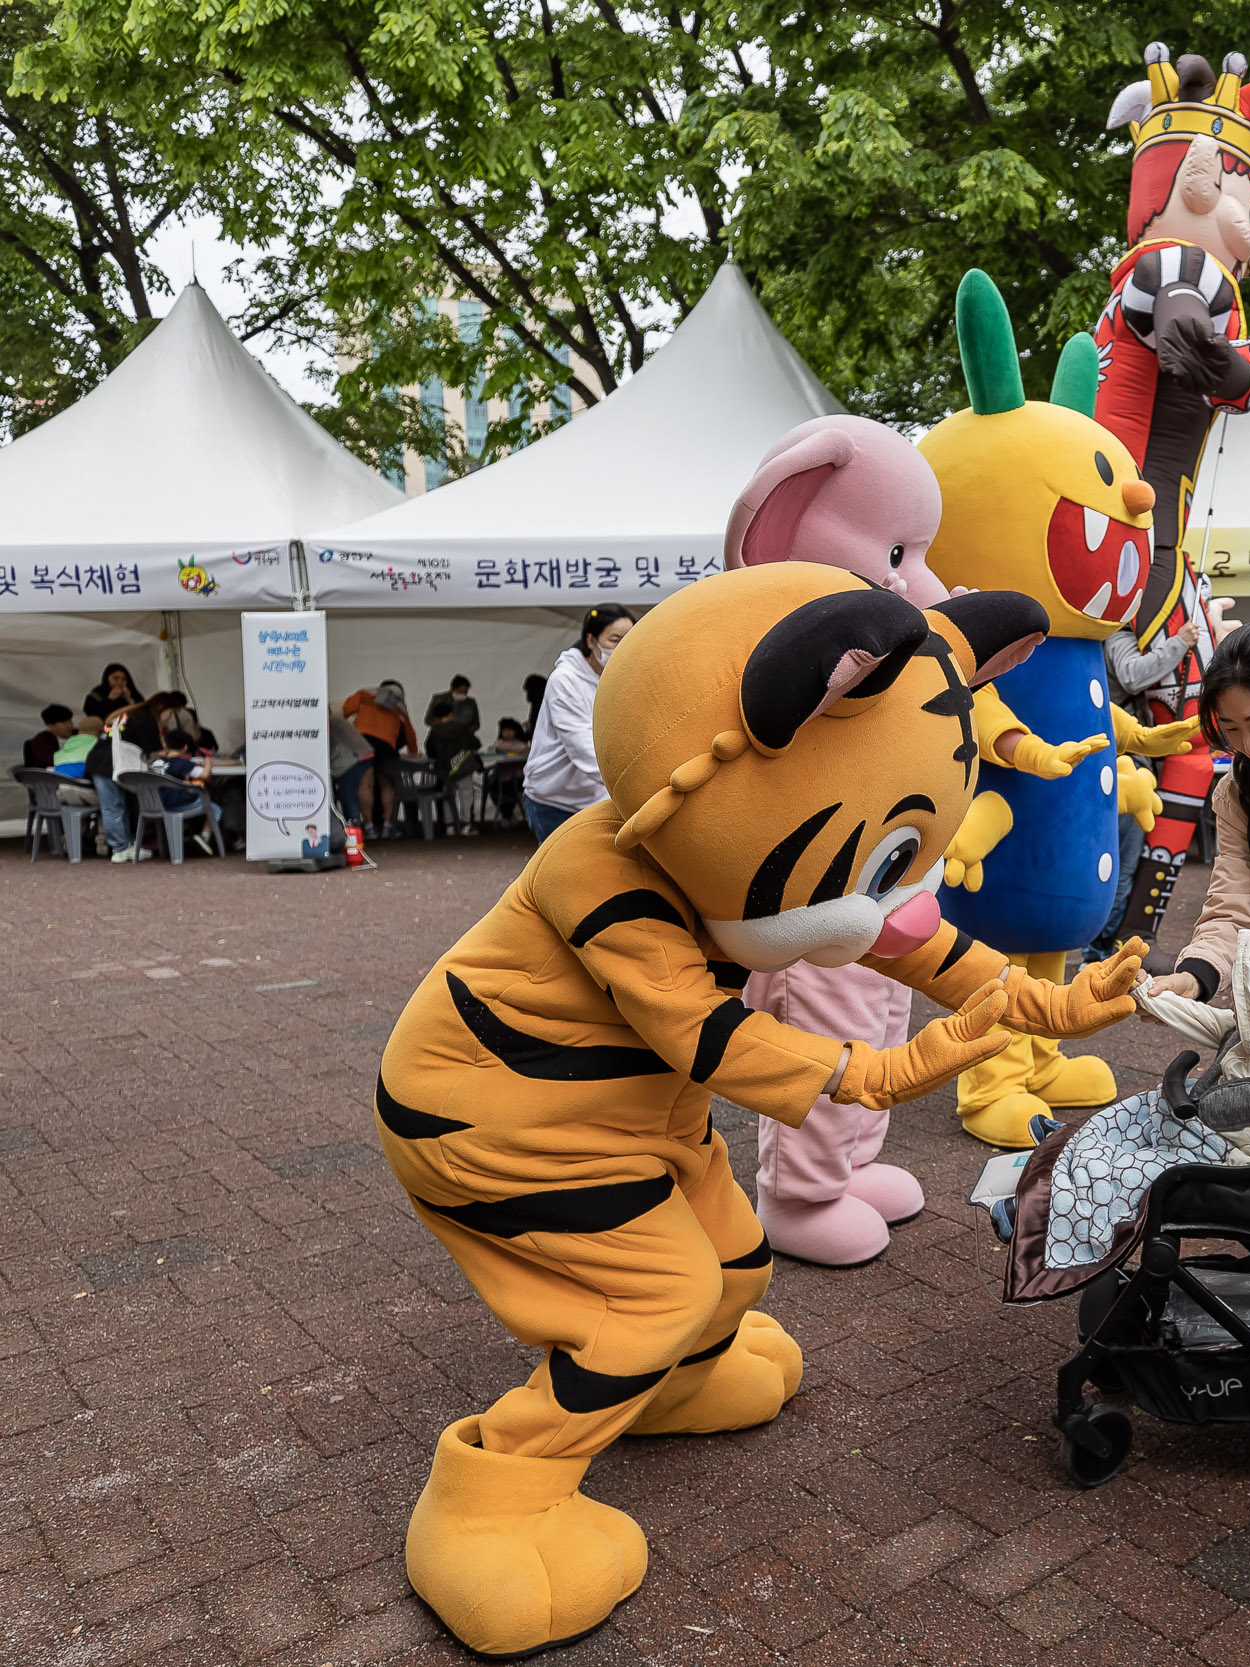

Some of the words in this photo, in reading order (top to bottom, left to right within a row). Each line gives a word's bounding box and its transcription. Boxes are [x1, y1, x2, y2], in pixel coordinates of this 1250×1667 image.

[31, 563, 142, 596] 복식체험
[474, 556, 622, 590] 문화재발굴
[635, 556, 661, 588] 및
[1180, 1378, 1243, 1401] Y-UP
